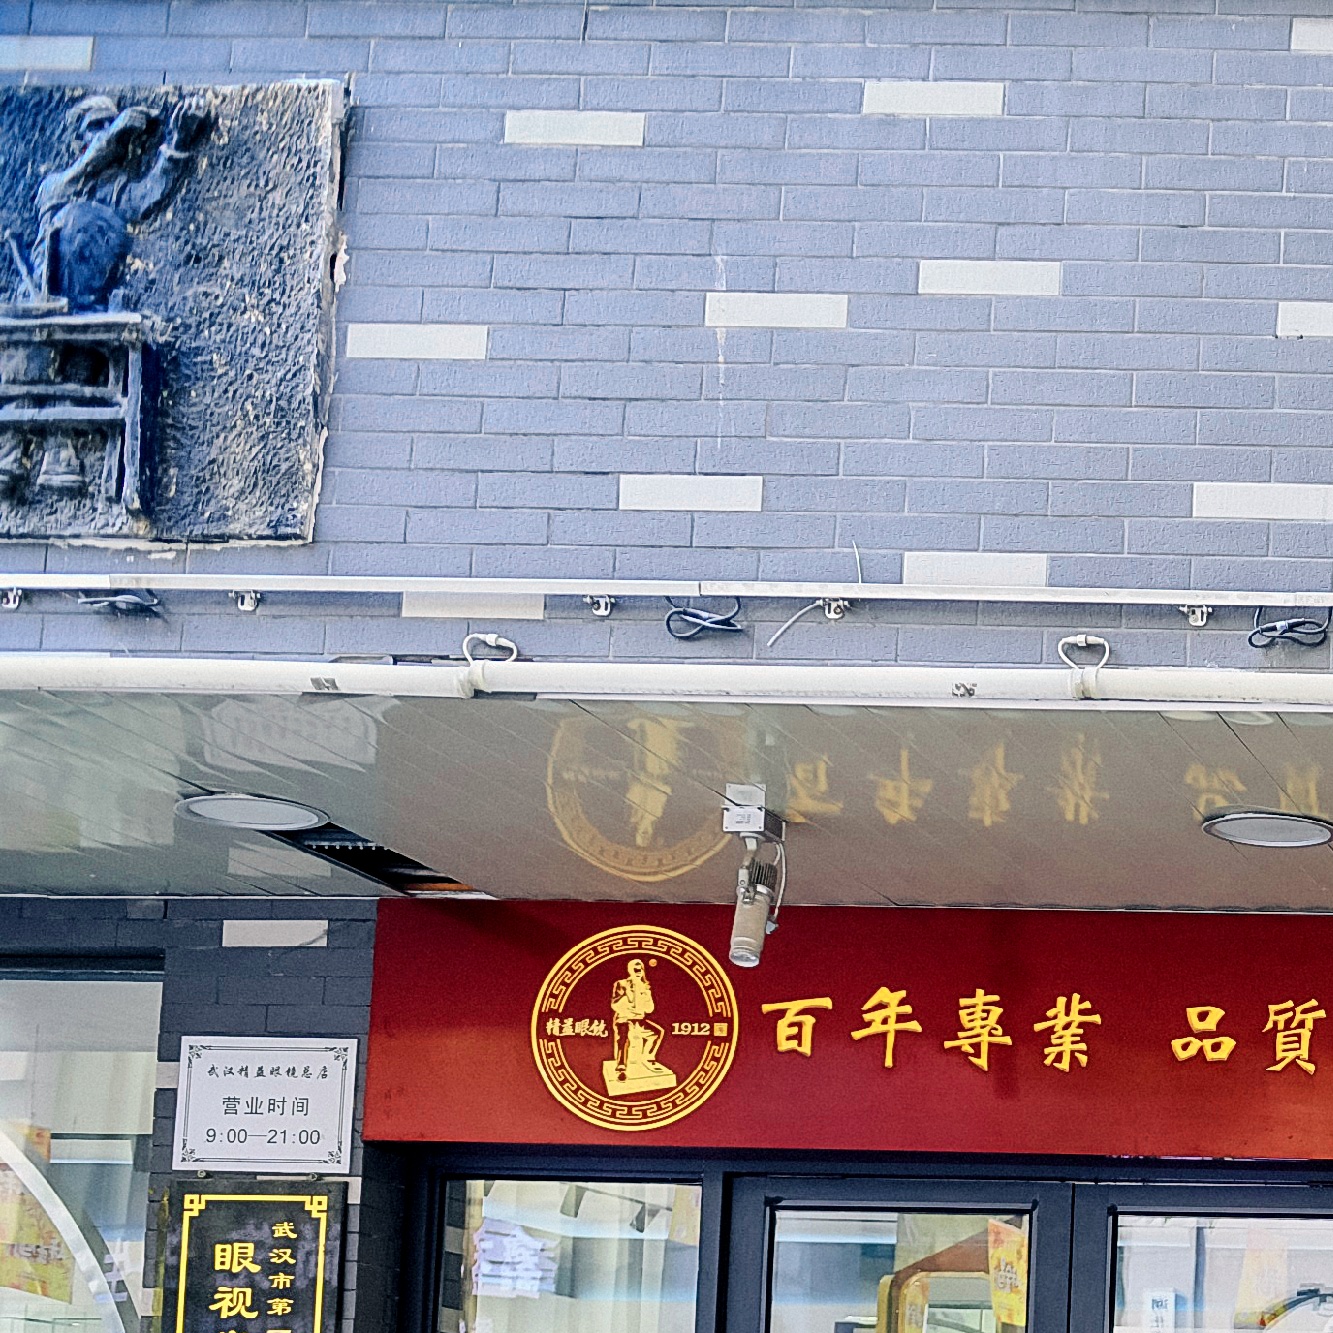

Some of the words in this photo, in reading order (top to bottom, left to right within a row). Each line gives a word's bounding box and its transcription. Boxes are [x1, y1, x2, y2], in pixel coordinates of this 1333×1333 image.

[671, 1022, 711, 1036] 1912
[762, 987, 1102, 1071] 百年專業
[222, 1096, 309, 1116] 营业时间
